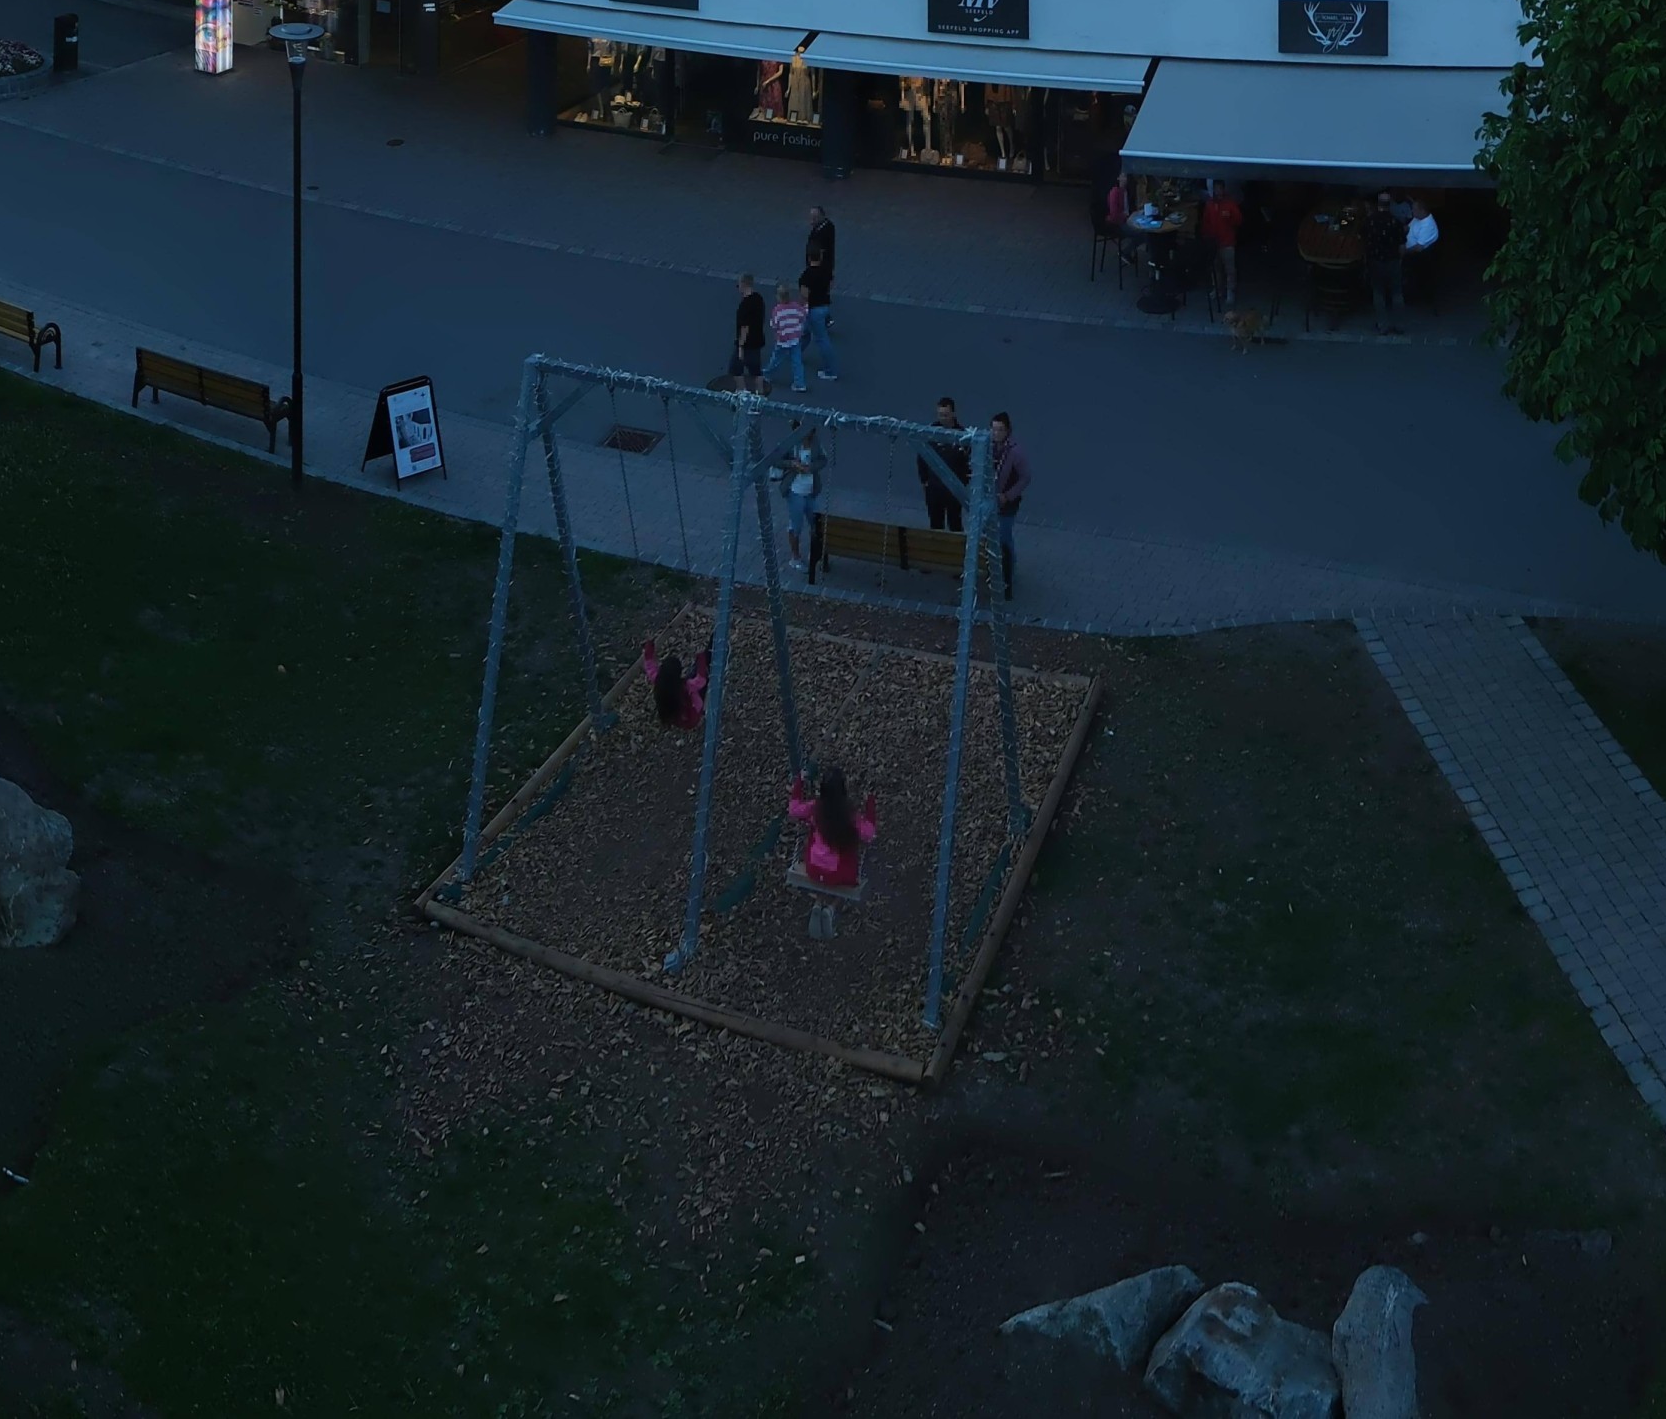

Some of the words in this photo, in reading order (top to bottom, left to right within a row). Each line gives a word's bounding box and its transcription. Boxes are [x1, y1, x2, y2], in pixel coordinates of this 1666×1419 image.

[938, 24, 967, 32] SEEFELD
[969, 26, 1004, 34] SHOPPING
[753, 131, 779, 143] pure
